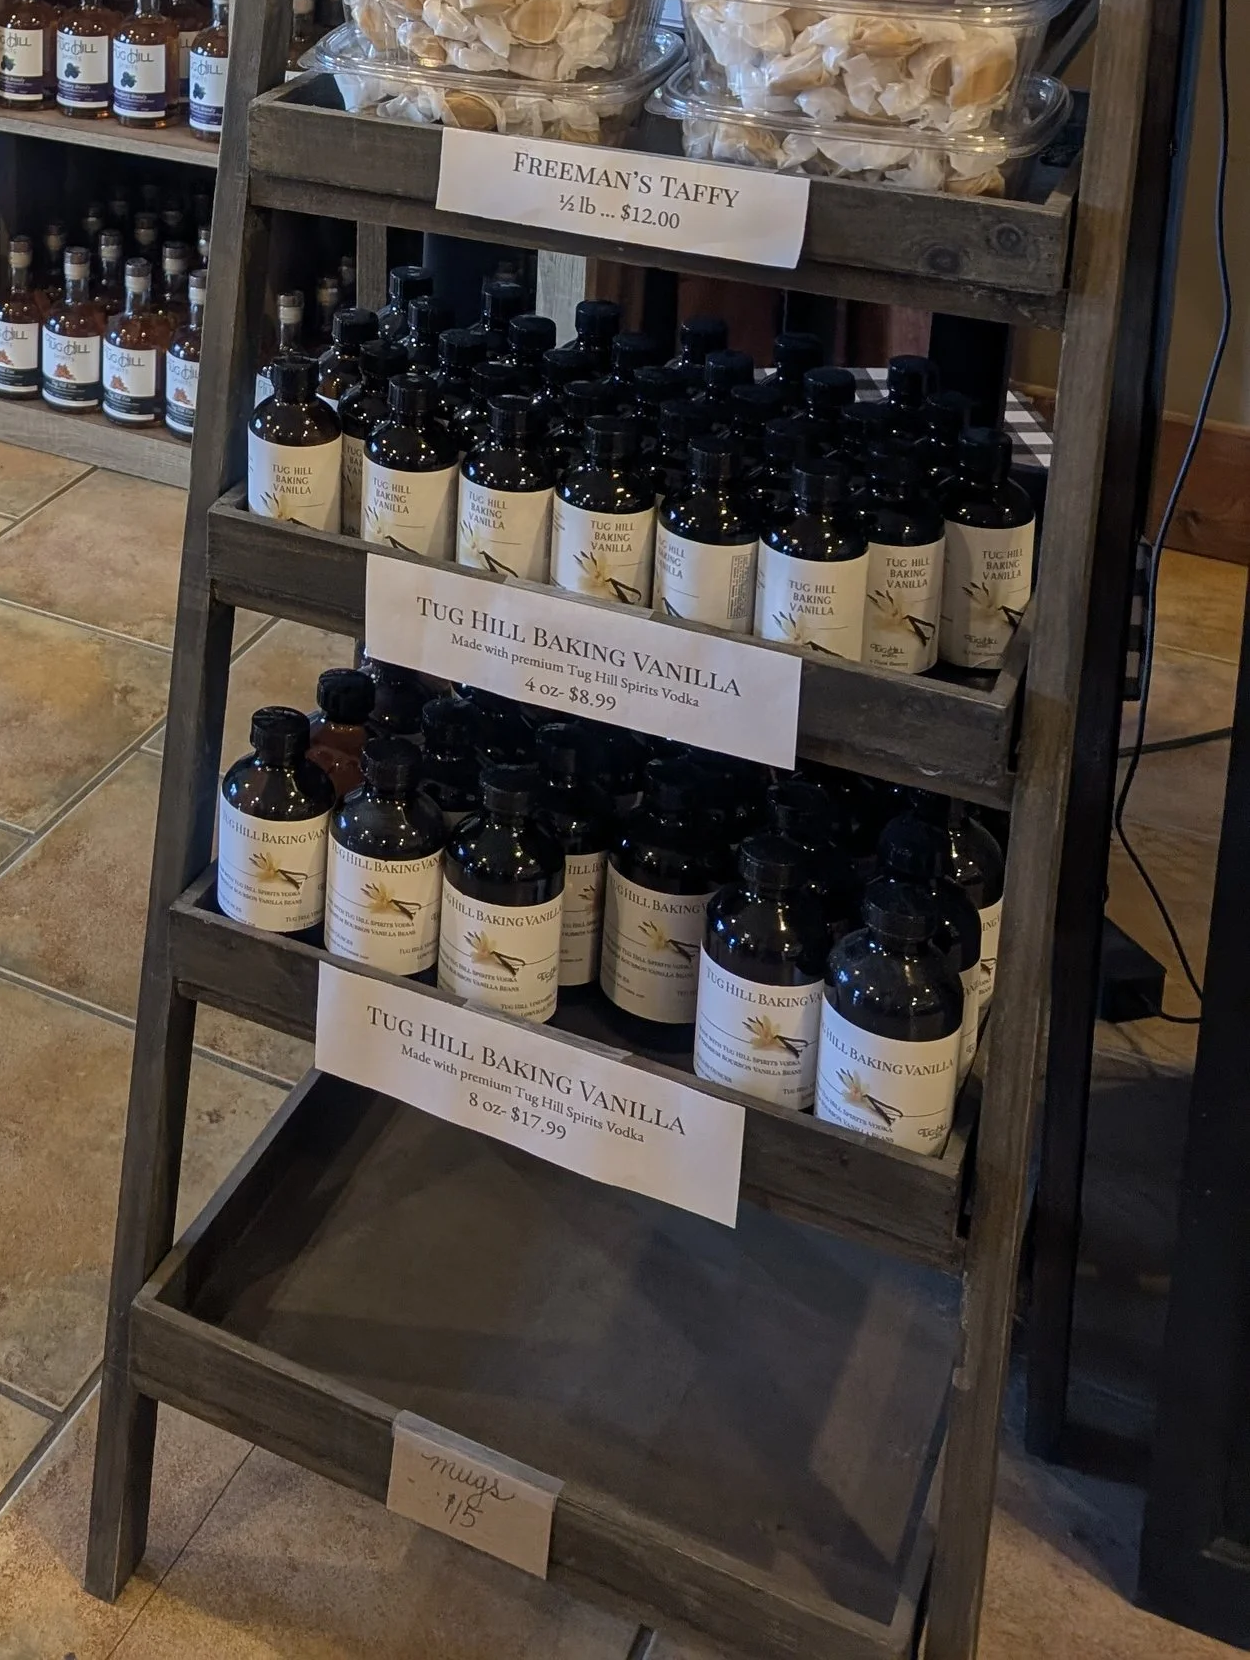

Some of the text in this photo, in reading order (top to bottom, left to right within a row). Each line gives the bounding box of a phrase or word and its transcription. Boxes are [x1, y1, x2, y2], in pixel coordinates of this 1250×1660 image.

[579, 195, 596, 216] lb
[620, 204, 681, 229] $12.00
[272, 464, 313, 475] TUG HILL
[276, 476, 308, 484] BAKING
[273, 484, 312, 494] VANILLA
[591, 520, 634, 531] TUG HILL
[594, 532, 631, 541] BAKING
[591, 542, 633, 552] VANILLA
[982, 549, 1023, 559] TUG HILL
[886, 558, 930, 567] TUG HILL
[986, 560, 1020, 570] BAKING
[890, 569, 926, 578] BAKING
[982, 570, 1022, 580] VANILLA
[789, 580, 836, 594] TUG HILL
[887, 580, 928, 589] VANILLA
[793, 593, 831, 605] BAKING
[790, 602, 834, 615] VANILLA
[534, 627, 627, 669] BAKING
[634, 652, 742, 698] VANILLA
[451, 633, 700, 708] Made with premium Tug Hill Spirits Vodka
[524, 676, 535, 693] 4
[569, 685, 617, 712] $8.99
[826, 1030, 849, 1055] HILL
[850, 1047, 903, 1074] BAKING
[401, 1044, 645, 1143] Made with premium Tug Hill Spirits Vodka
[482, 1046, 572, 1096] BAKING
[580, 1080, 687, 1137] VANILLA
[468, 1091, 479, 1108] 8
[510, 1107, 568, 1140] $17.99
